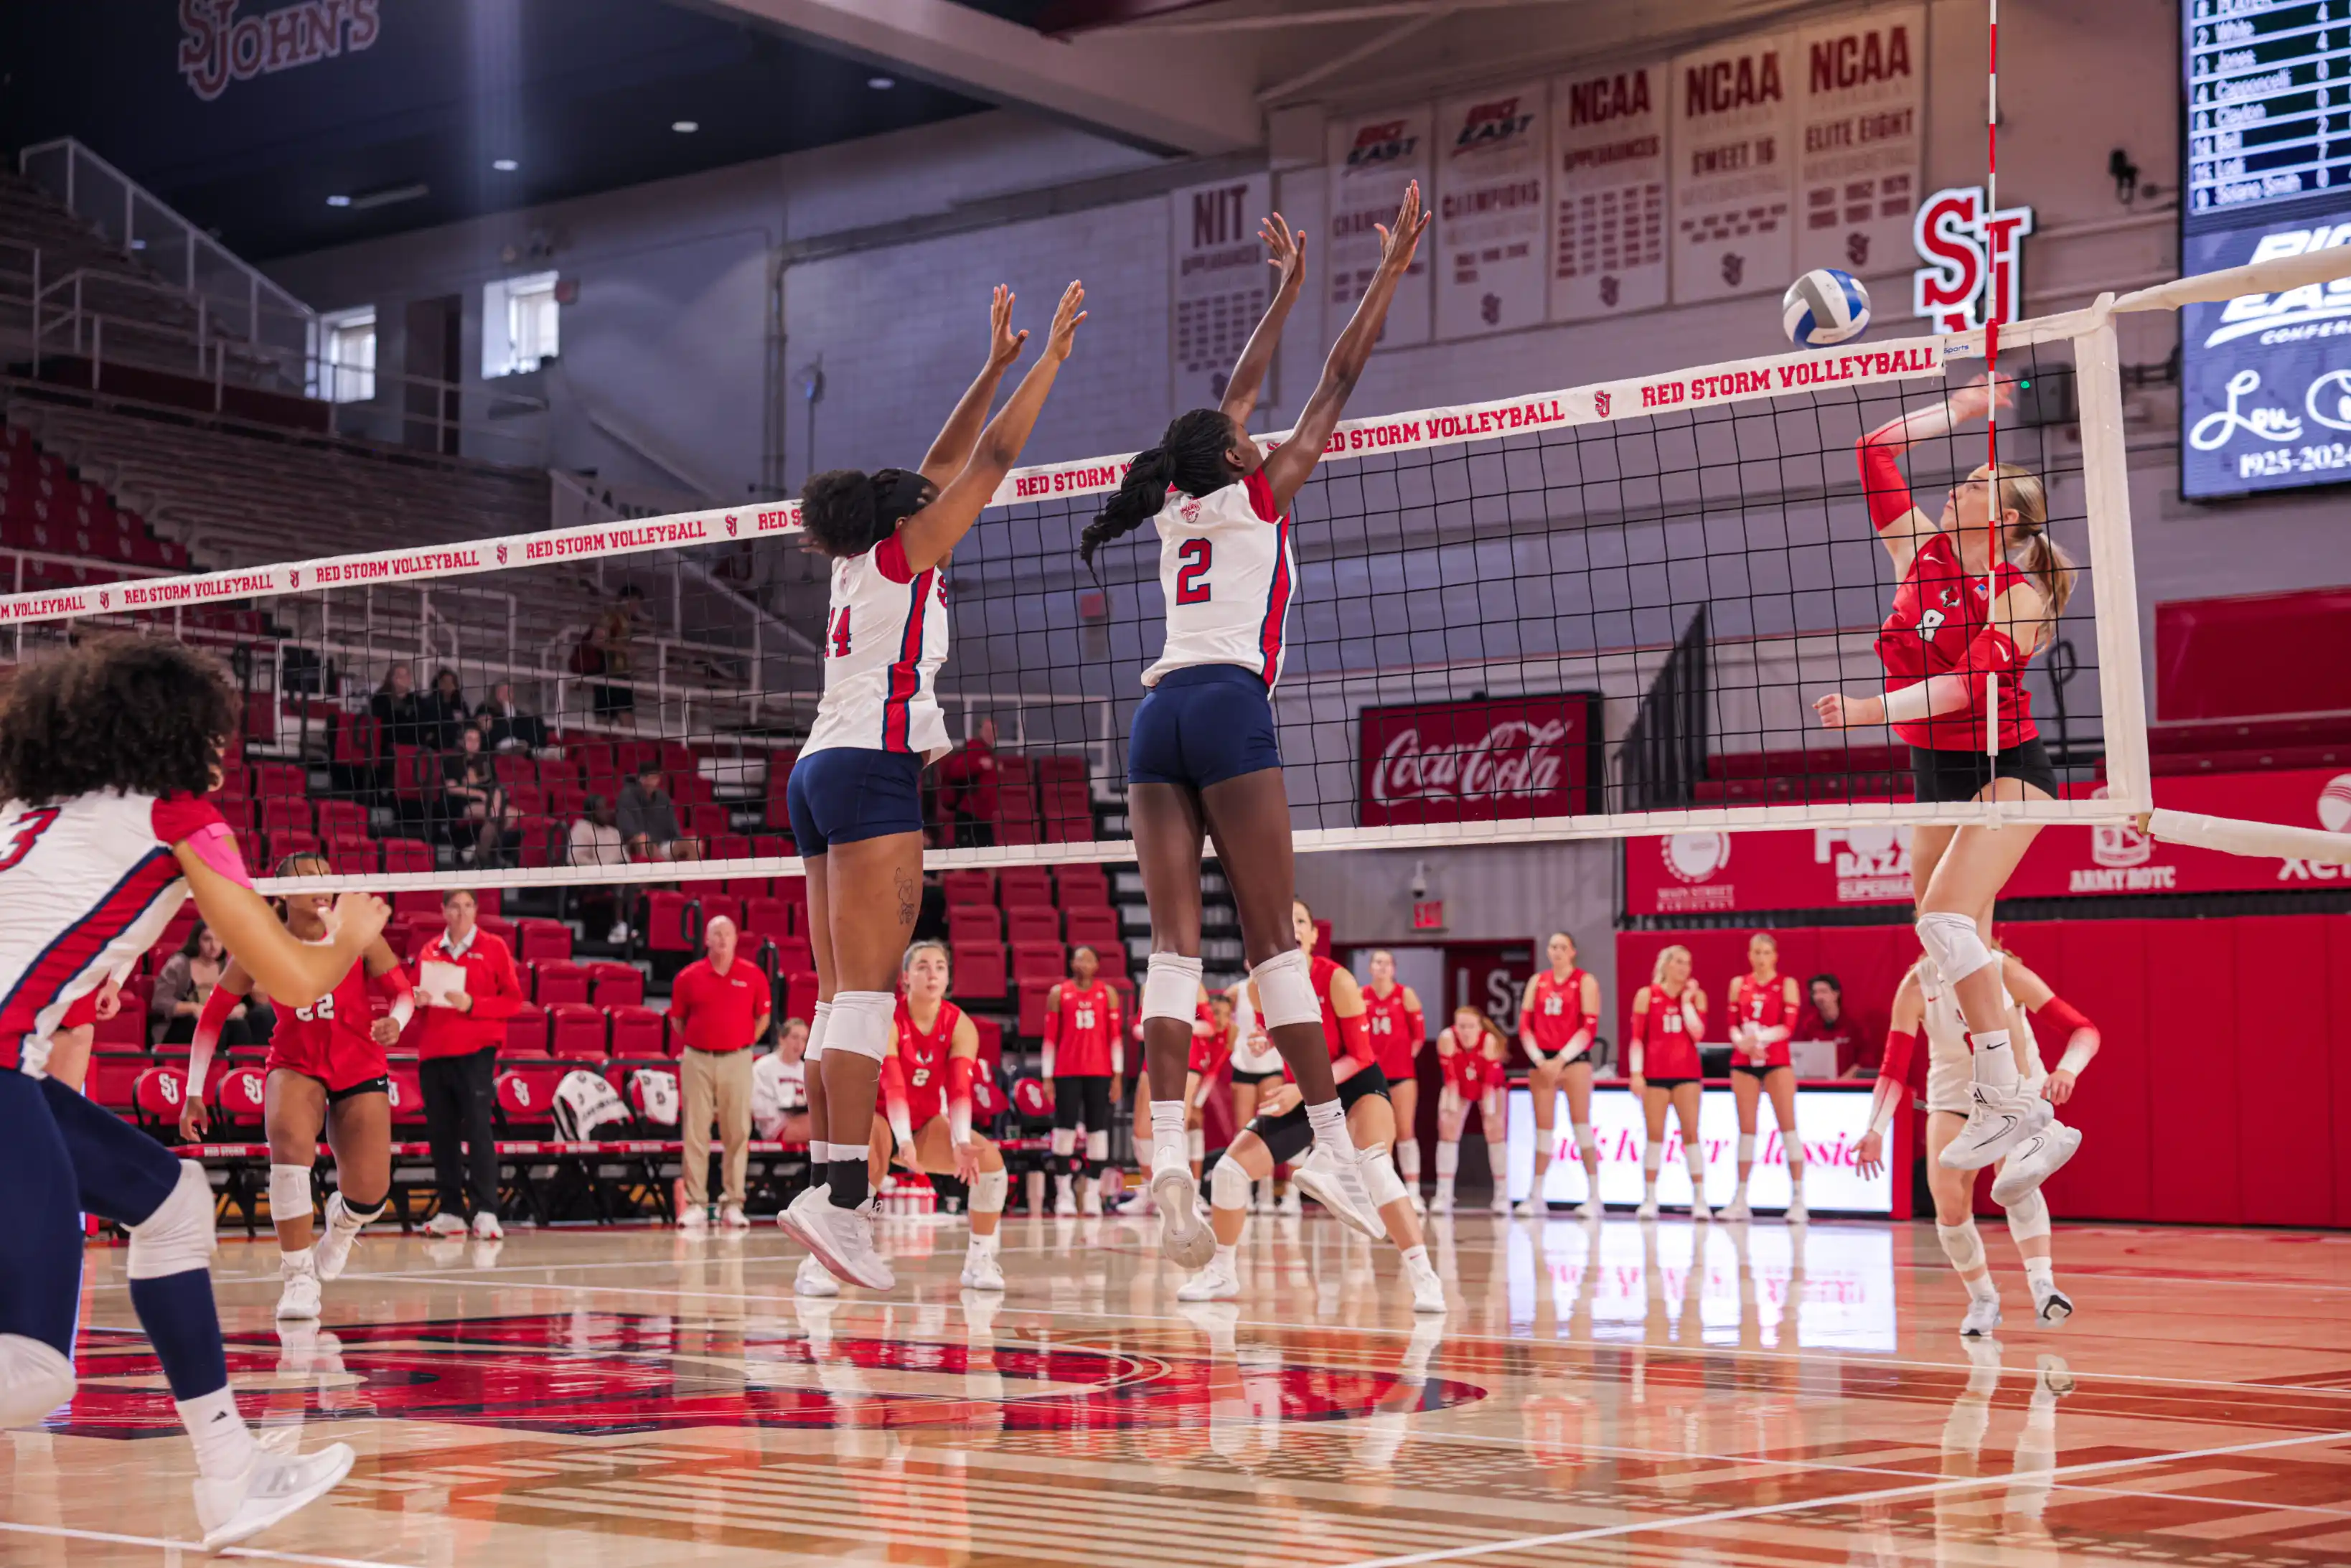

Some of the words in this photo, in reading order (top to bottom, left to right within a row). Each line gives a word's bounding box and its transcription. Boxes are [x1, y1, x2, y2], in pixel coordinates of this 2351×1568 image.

[1809, 26, 1910, 94] NCAA
[1569, 69, 1651, 128] NCAA
[1686, 51, 1782, 119] NCAA
[1804, 119, 1852, 153] ELITE
[1860, 108, 1913, 143] EIGHT
[1193, 184, 1249, 249] NIT
[1641, 382, 1684, 408] RED
[1691, 369, 1770, 400] STORM
[1778, 347, 1936, 388] VOLLEYBALL
[1322, 433, 1346, 454] ED
[1351, 422, 1420, 449] STORM
[1426, 400, 1564, 439] VOLLEYBALL
[2189, 369, 2302, 450] Lou
[1015, 476, 1049, 497] RED
[1054, 465, 1116, 492] STORM
[2239, 441, 2351, 479] 1925-202
[526, 540, 553, 559] RED
[556, 533, 606, 554] STORM
[609, 520, 706, 549] VOLLEYBALL
[758, 510, 787, 531] RED
[125, 586, 148, 604] RED
[150, 580, 191, 601] STORM
[194, 573, 273, 597] VOLLEYBALL
[316, 565, 340, 583] RED
[344, 559, 388, 580] STORM
[393, 550, 479, 576] VOLLEYBALL
[1176, 537, 1212, 606] 2
[14, 596, 85, 617] VOLLEYBALL
[1371, 718, 1573, 807] Coca-Cola
[2070, 870, 2126, 892] ARMY
[2129, 865, 2176, 889] ROTC
[911, 1068, 931, 1087] 2
